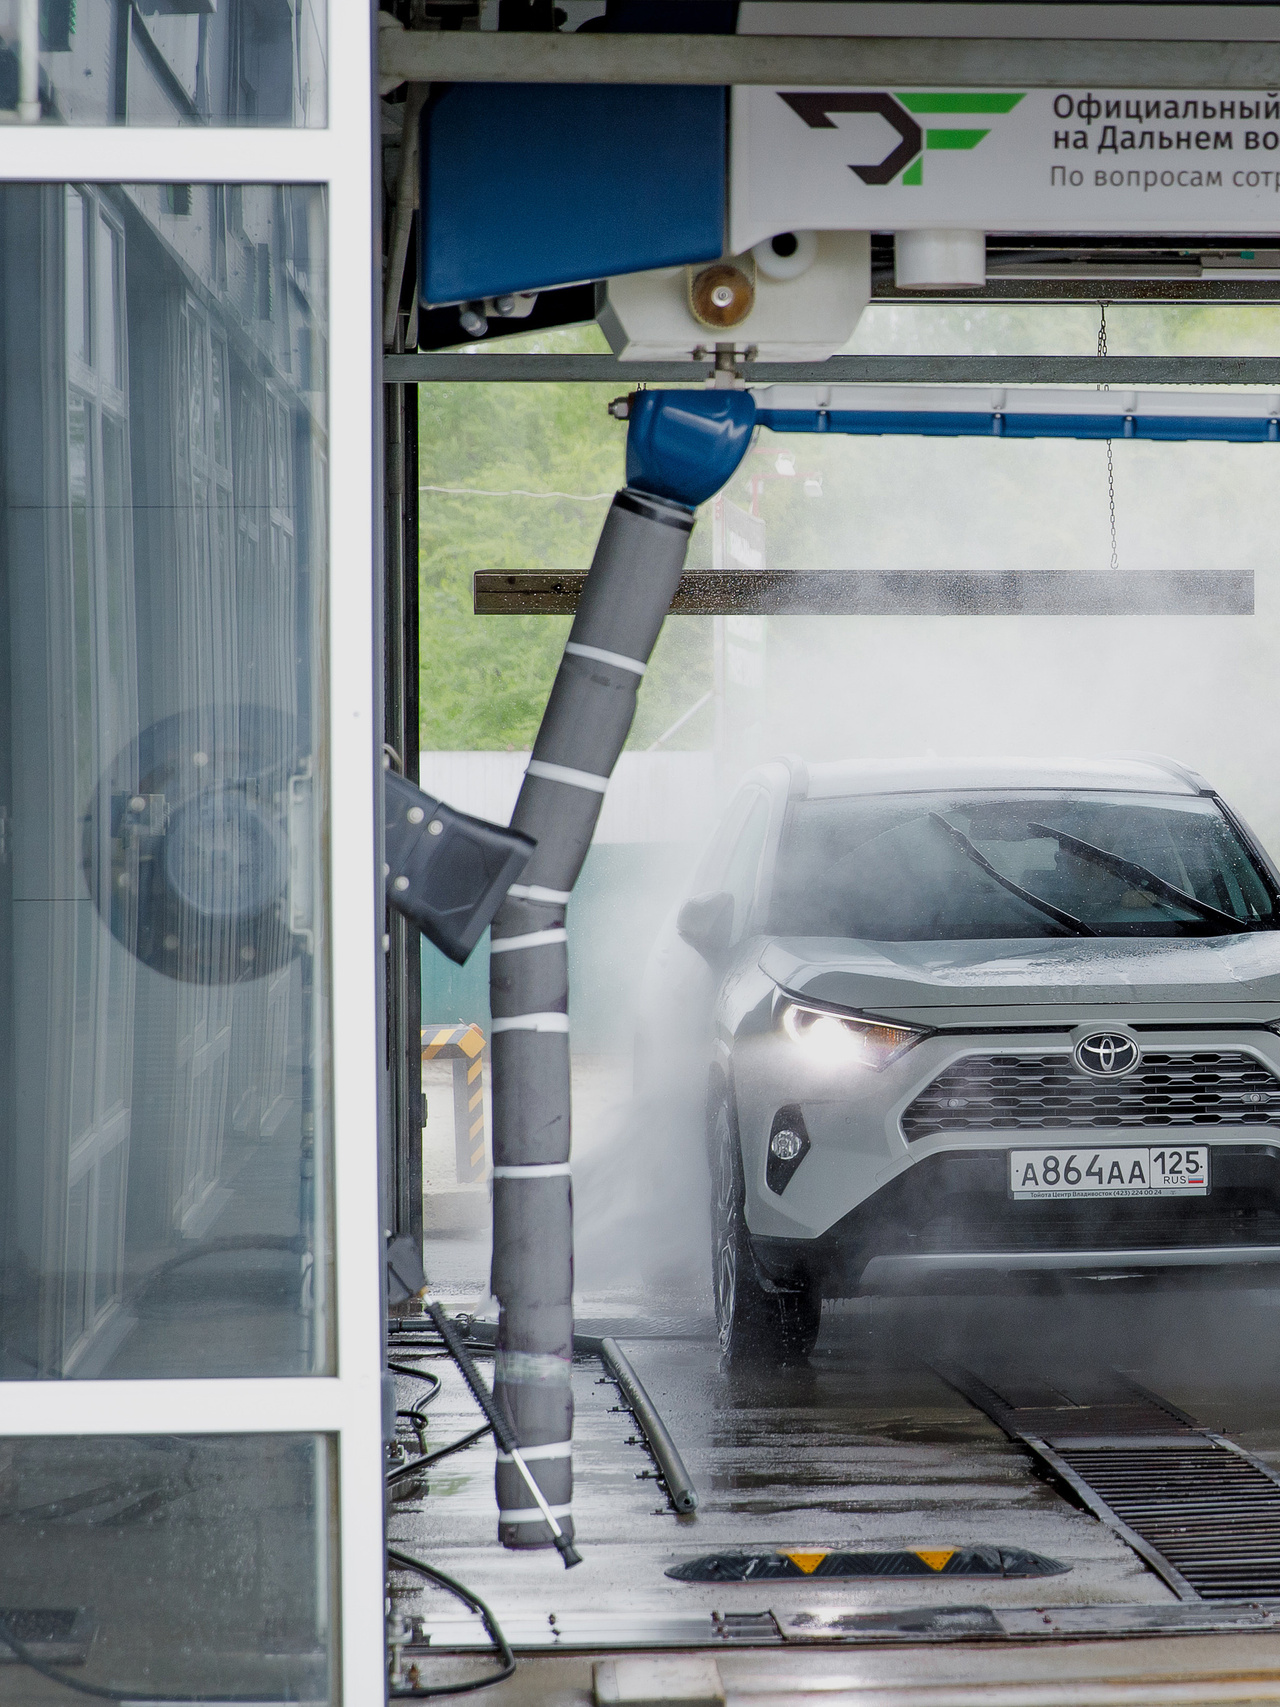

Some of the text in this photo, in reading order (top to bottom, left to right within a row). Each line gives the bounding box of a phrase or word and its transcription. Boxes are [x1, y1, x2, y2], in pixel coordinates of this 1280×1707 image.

[1053, 92, 1280, 124] Официальный
[1053, 130, 1089, 149] на
[1096, 125, 1234, 155] Дальнем
[1050, 165, 1084, 187] По
[1094, 169, 1223, 193] вопросам
[1153, 1150, 1200, 1175] 125
[1163, 1175, 1187, 1185] RUS
[1030, 1191, 1051, 1199] Тойота
[1052, 1190, 1072, 1199] Центр
[1072, 1190, 1112, 1198] Владивосток
[1113, 1189, 1131, 1197] (423)
